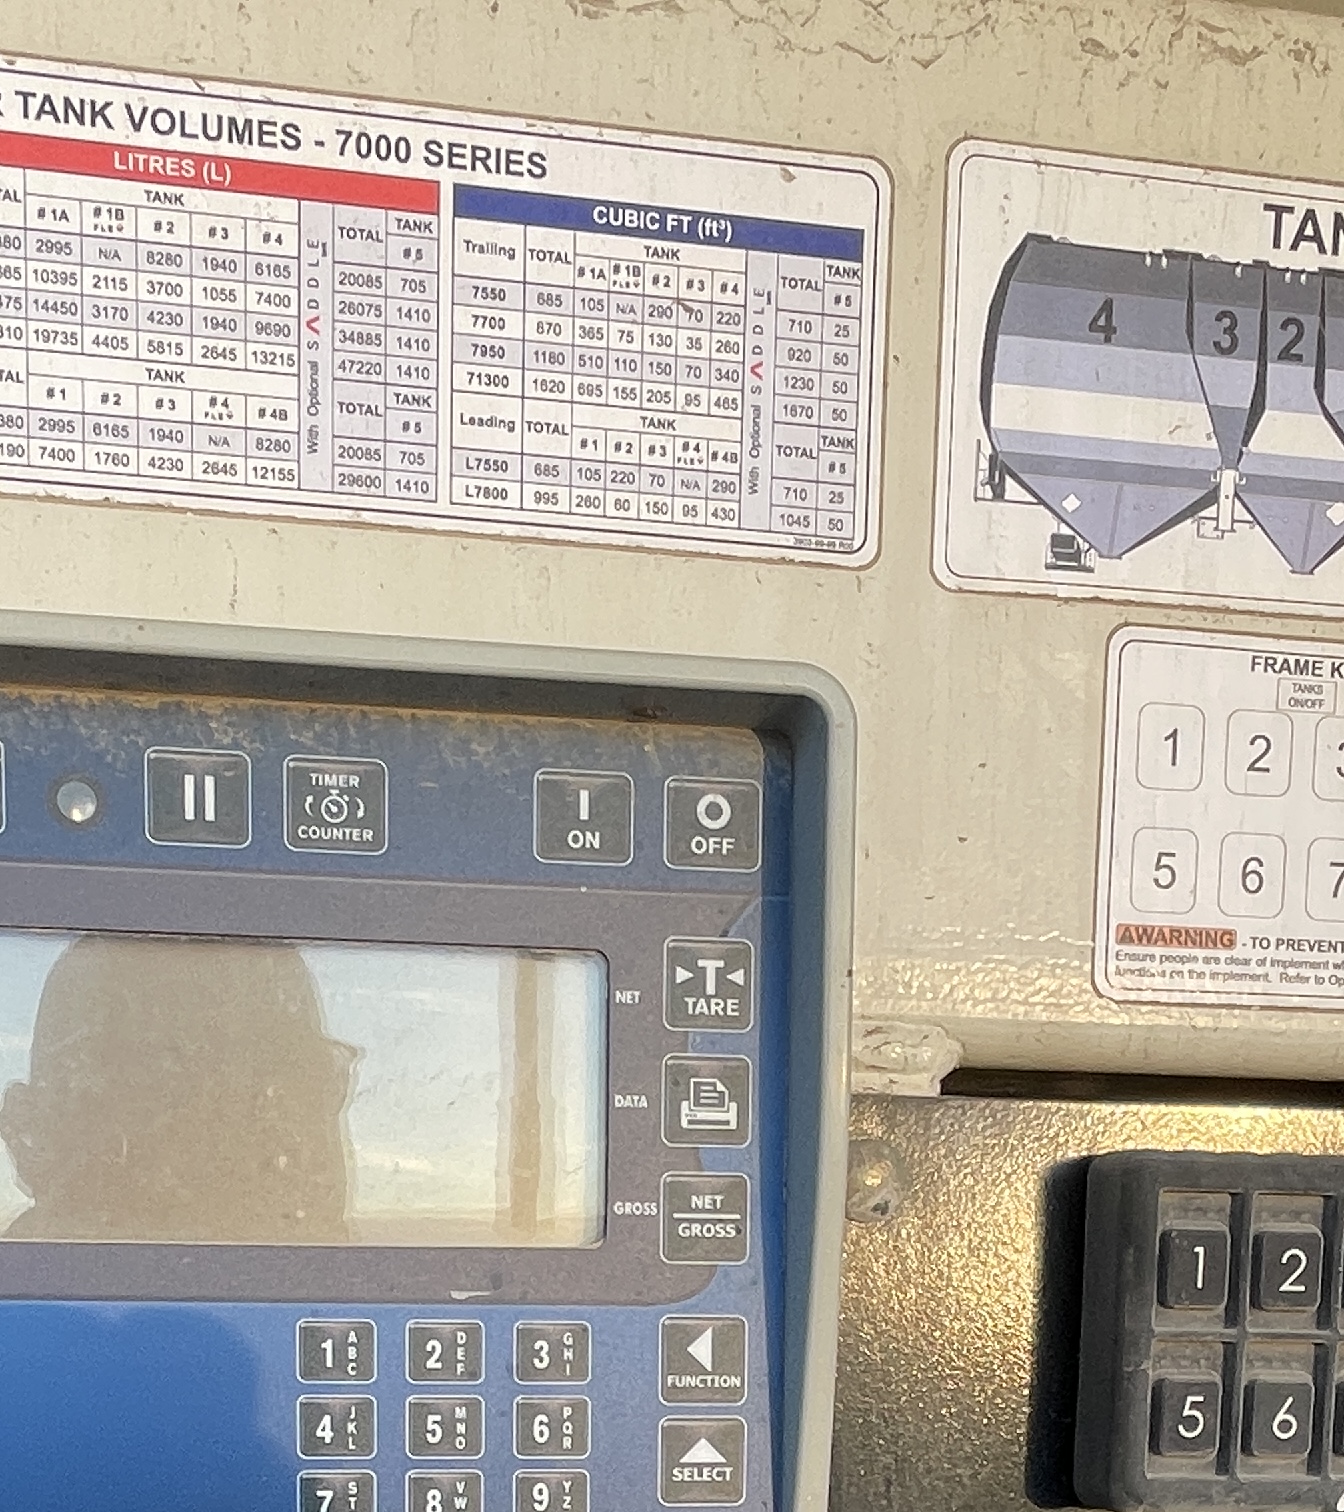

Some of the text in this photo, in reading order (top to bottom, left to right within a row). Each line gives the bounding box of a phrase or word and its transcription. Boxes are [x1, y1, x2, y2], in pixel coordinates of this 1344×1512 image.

[16, 90, 114, 131] TANK
[125, 102, 302, 152] VOLUMES
[335, 128, 412, 165] 7000
[423, 140, 548, 180] SERIES
[113, 149, 232, 188] LITRES (L)
[593, 206, 659, 233] CUBIC
[665, 212, 693, 235] FT
[33, 269, 128, 291] 10395 2115
[401, 278, 426, 293] 705
[33, 300, 78, 316] 14450
[91, 305, 129, 321] 3170
[472, 286, 604, 312] 7550 105
[397, 306, 431, 322] 1410
[1087, 297, 1118, 344] 4
[34, 330, 129, 350] 19735 4405
[788, 319, 850, 338] 710 25
[1212, 309, 1240, 356] 3
[1276, 316, 1305, 362] 2
[648, 361, 672, 376] 150
[613, 387, 671, 404] 155 205
[1250, 655, 1324, 678] FRAME
[1164, 728, 1179, 767] 1
[1248, 734, 1272, 774] 2
[309, 773, 361, 789] TIMER
[296, 824, 375, 845] COUNTER
[566, 829, 601, 851] ON
[690, 834, 736, 856] OFF
[1153, 853, 1178, 890] 5
[1240, 857, 1264, 894] 6
[1134, 928, 1235, 949] WARNING
[1249, 936, 1270, 950] TO
[615, 989, 641, 1006] NET
[683, 997, 740, 1017] TARE
[614, 1094, 649, 1110] DATA
[613, 1200, 658, 1217] GROSS
[690, 1194, 725, 1211] NET
[677, 1221, 737, 1240] GROSS
[1191, 1246, 1206, 1290] 1
[1278, 1248, 1308, 1293] 2
[320, 1340, 334, 1367] 1
[425, 1340, 443, 1368] 2
[533, 1339, 551, 1367] 3
[667, 1374, 742, 1389] FUNCTION
[315, 1416, 334, 1443] 4
[425, 1416, 443, 1443] 5
[533, 1415, 550, 1443] 6
[1177, 1396, 1205, 1439] 5
[1272, 1398, 1298, 1440] 6
[672, 1467, 734, 1483] SELECT
[533, 1483, 551, 1512] 9
